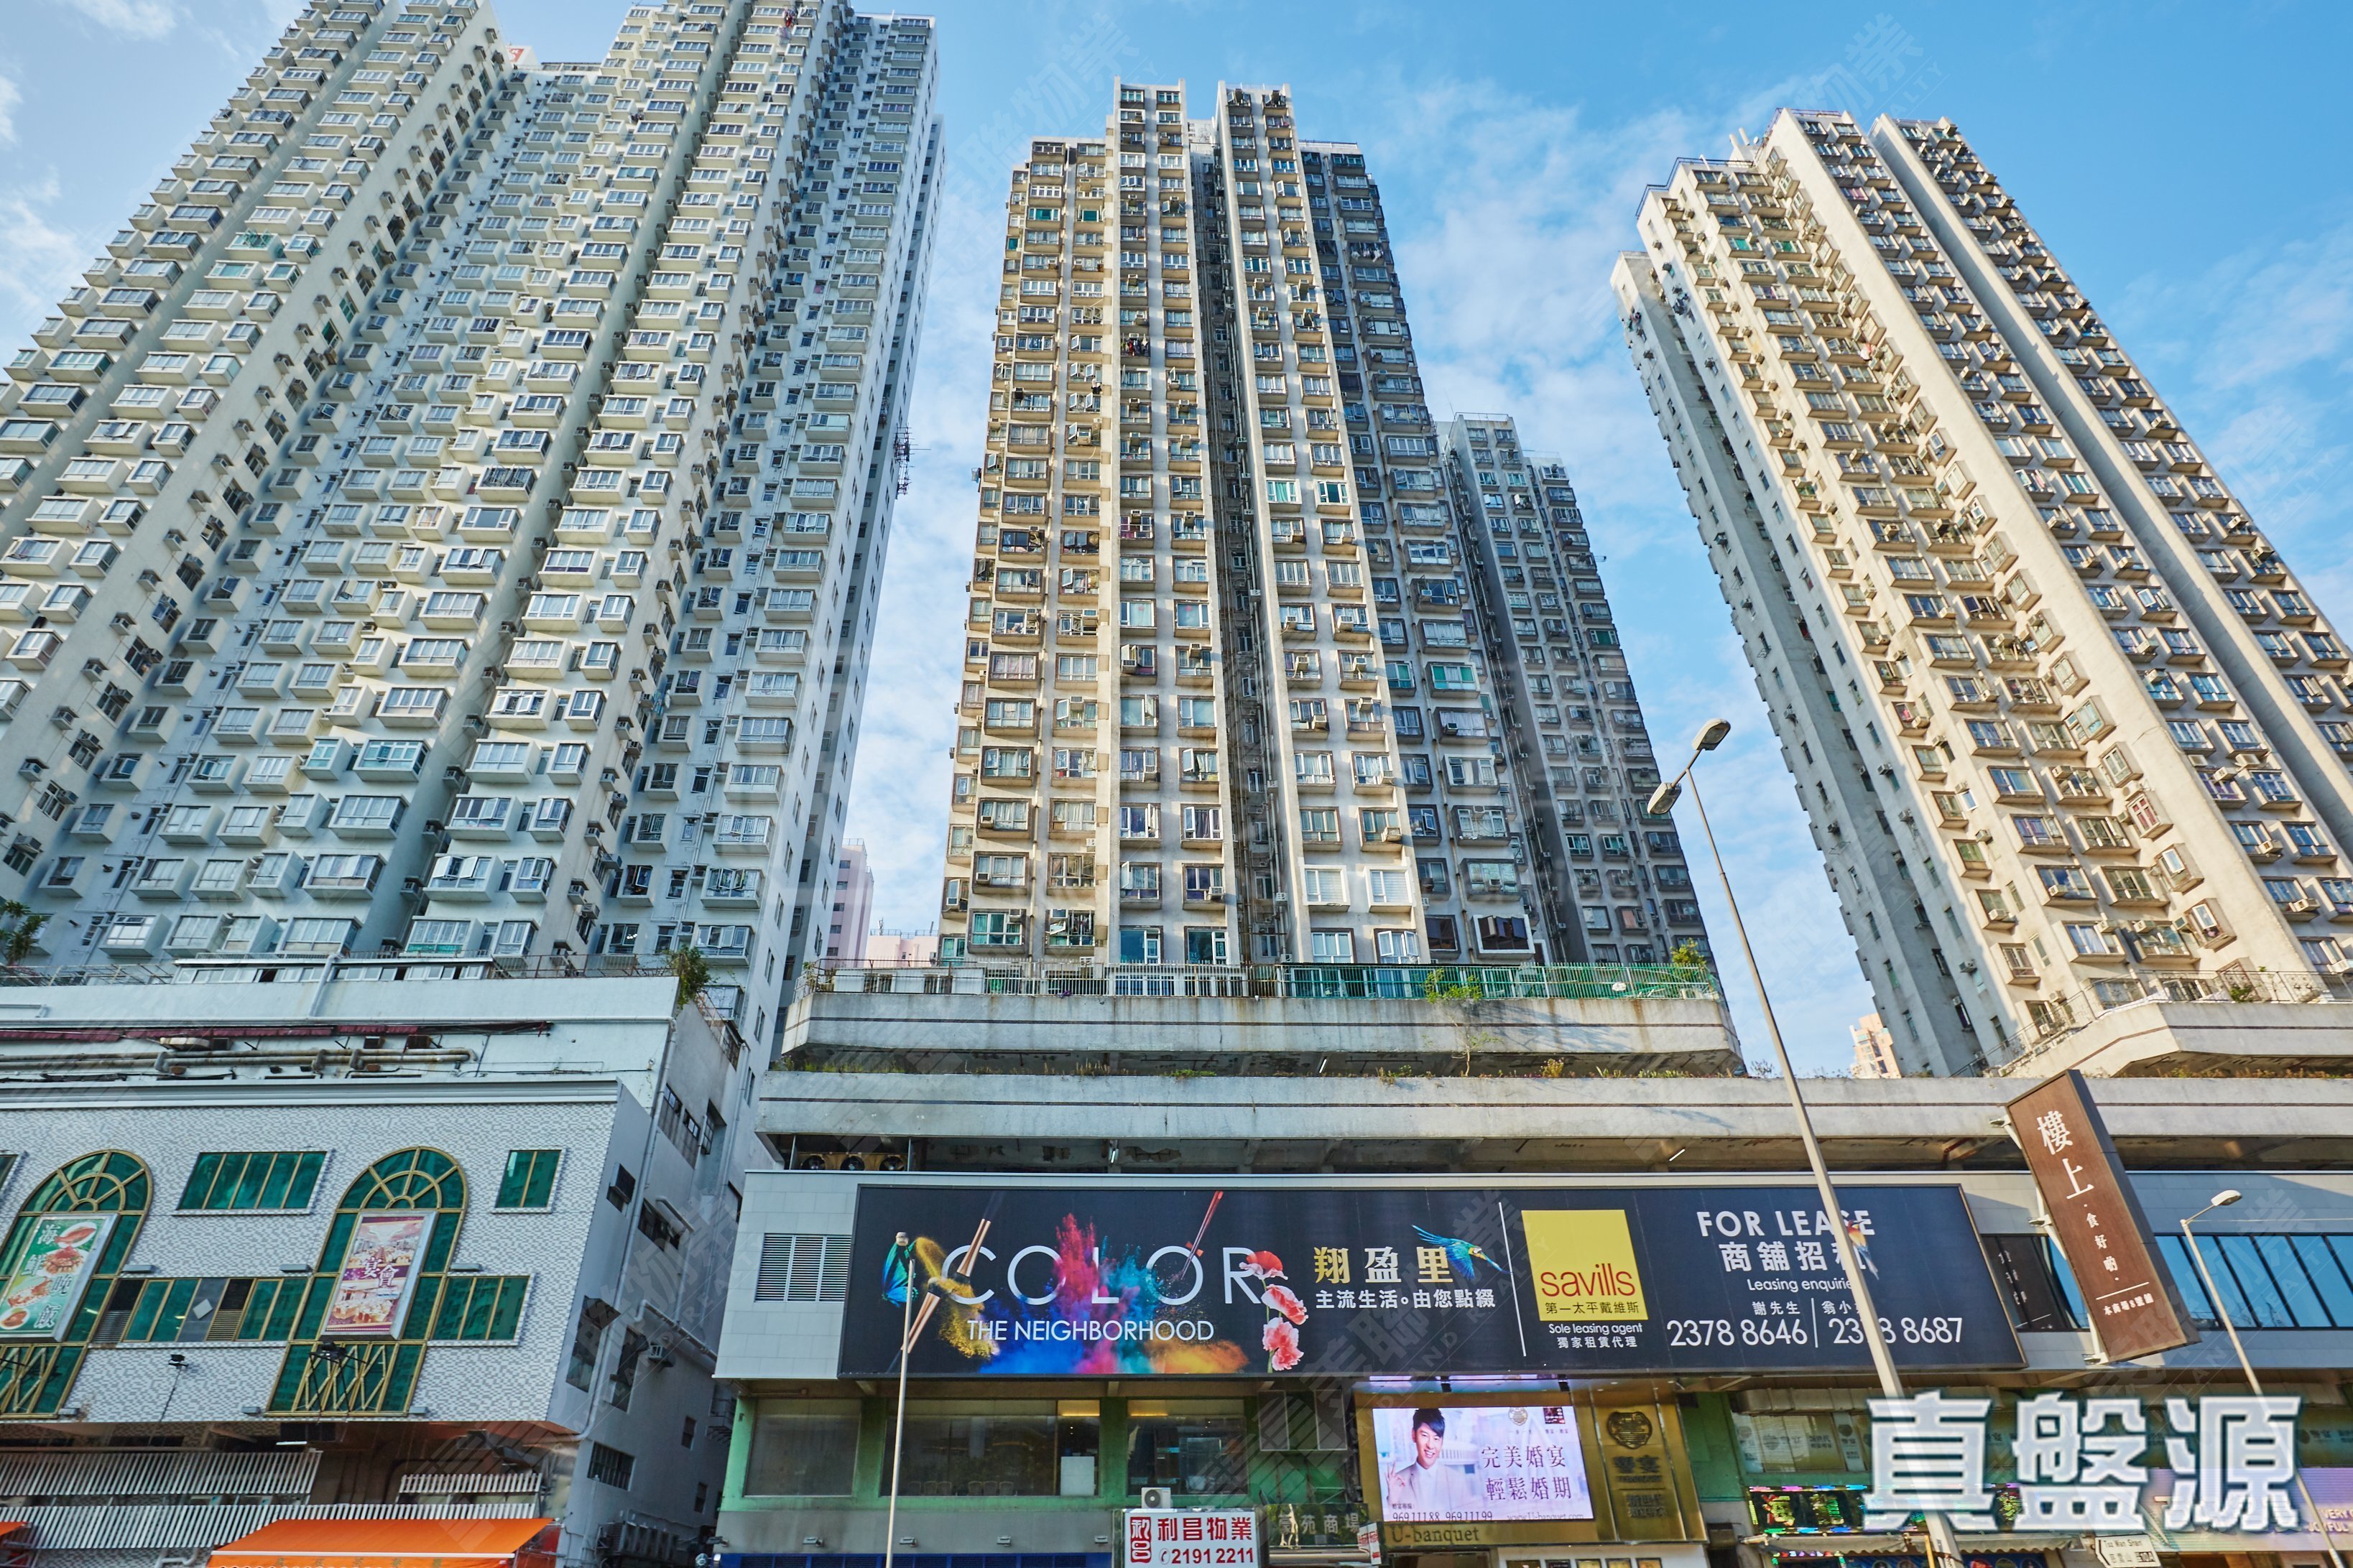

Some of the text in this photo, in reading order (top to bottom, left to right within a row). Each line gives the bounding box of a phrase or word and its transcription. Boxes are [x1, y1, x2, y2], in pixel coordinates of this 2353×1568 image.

[2036, 1110, 2094, 1200] 樓上
[1697, 1210, 1875, 1237] FOR LEAE
[361, 1256, 399, 1288] 宴會
[942, 1245, 1262, 1305] COLOR
[1314, 1246, 1453, 1284] 翔盈里
[1540, 1263, 1635, 1296] savills
[1747, 1278, 1852, 1292] Leasing enquirie
[1545, 1302, 1639, 1314] 第一太平戴維斯
[1752, 1301, 1800, 1316] 謝先生
[967, 1319, 1214, 1341] THE NEIGHBORHOOD
[1549, 1323, 1642, 1335] Sole leasing agent
[1667, 1319, 1807, 1346] 2378 8646
[1829, 1317, 1963, 1345] 238 8687
[1557, 1336, 1637, 1349] 獨家租賃代理
[1481, 1444, 1566, 1469] 完美婚宴
[1486, 1477, 1571, 1500] 輕鬆婚期
[1158, 1517, 1252, 1541] 利昌物業
[1390, 1524, 1480, 1544] U-banquet
[1171, 1547, 1253, 1564] 2191 2211
